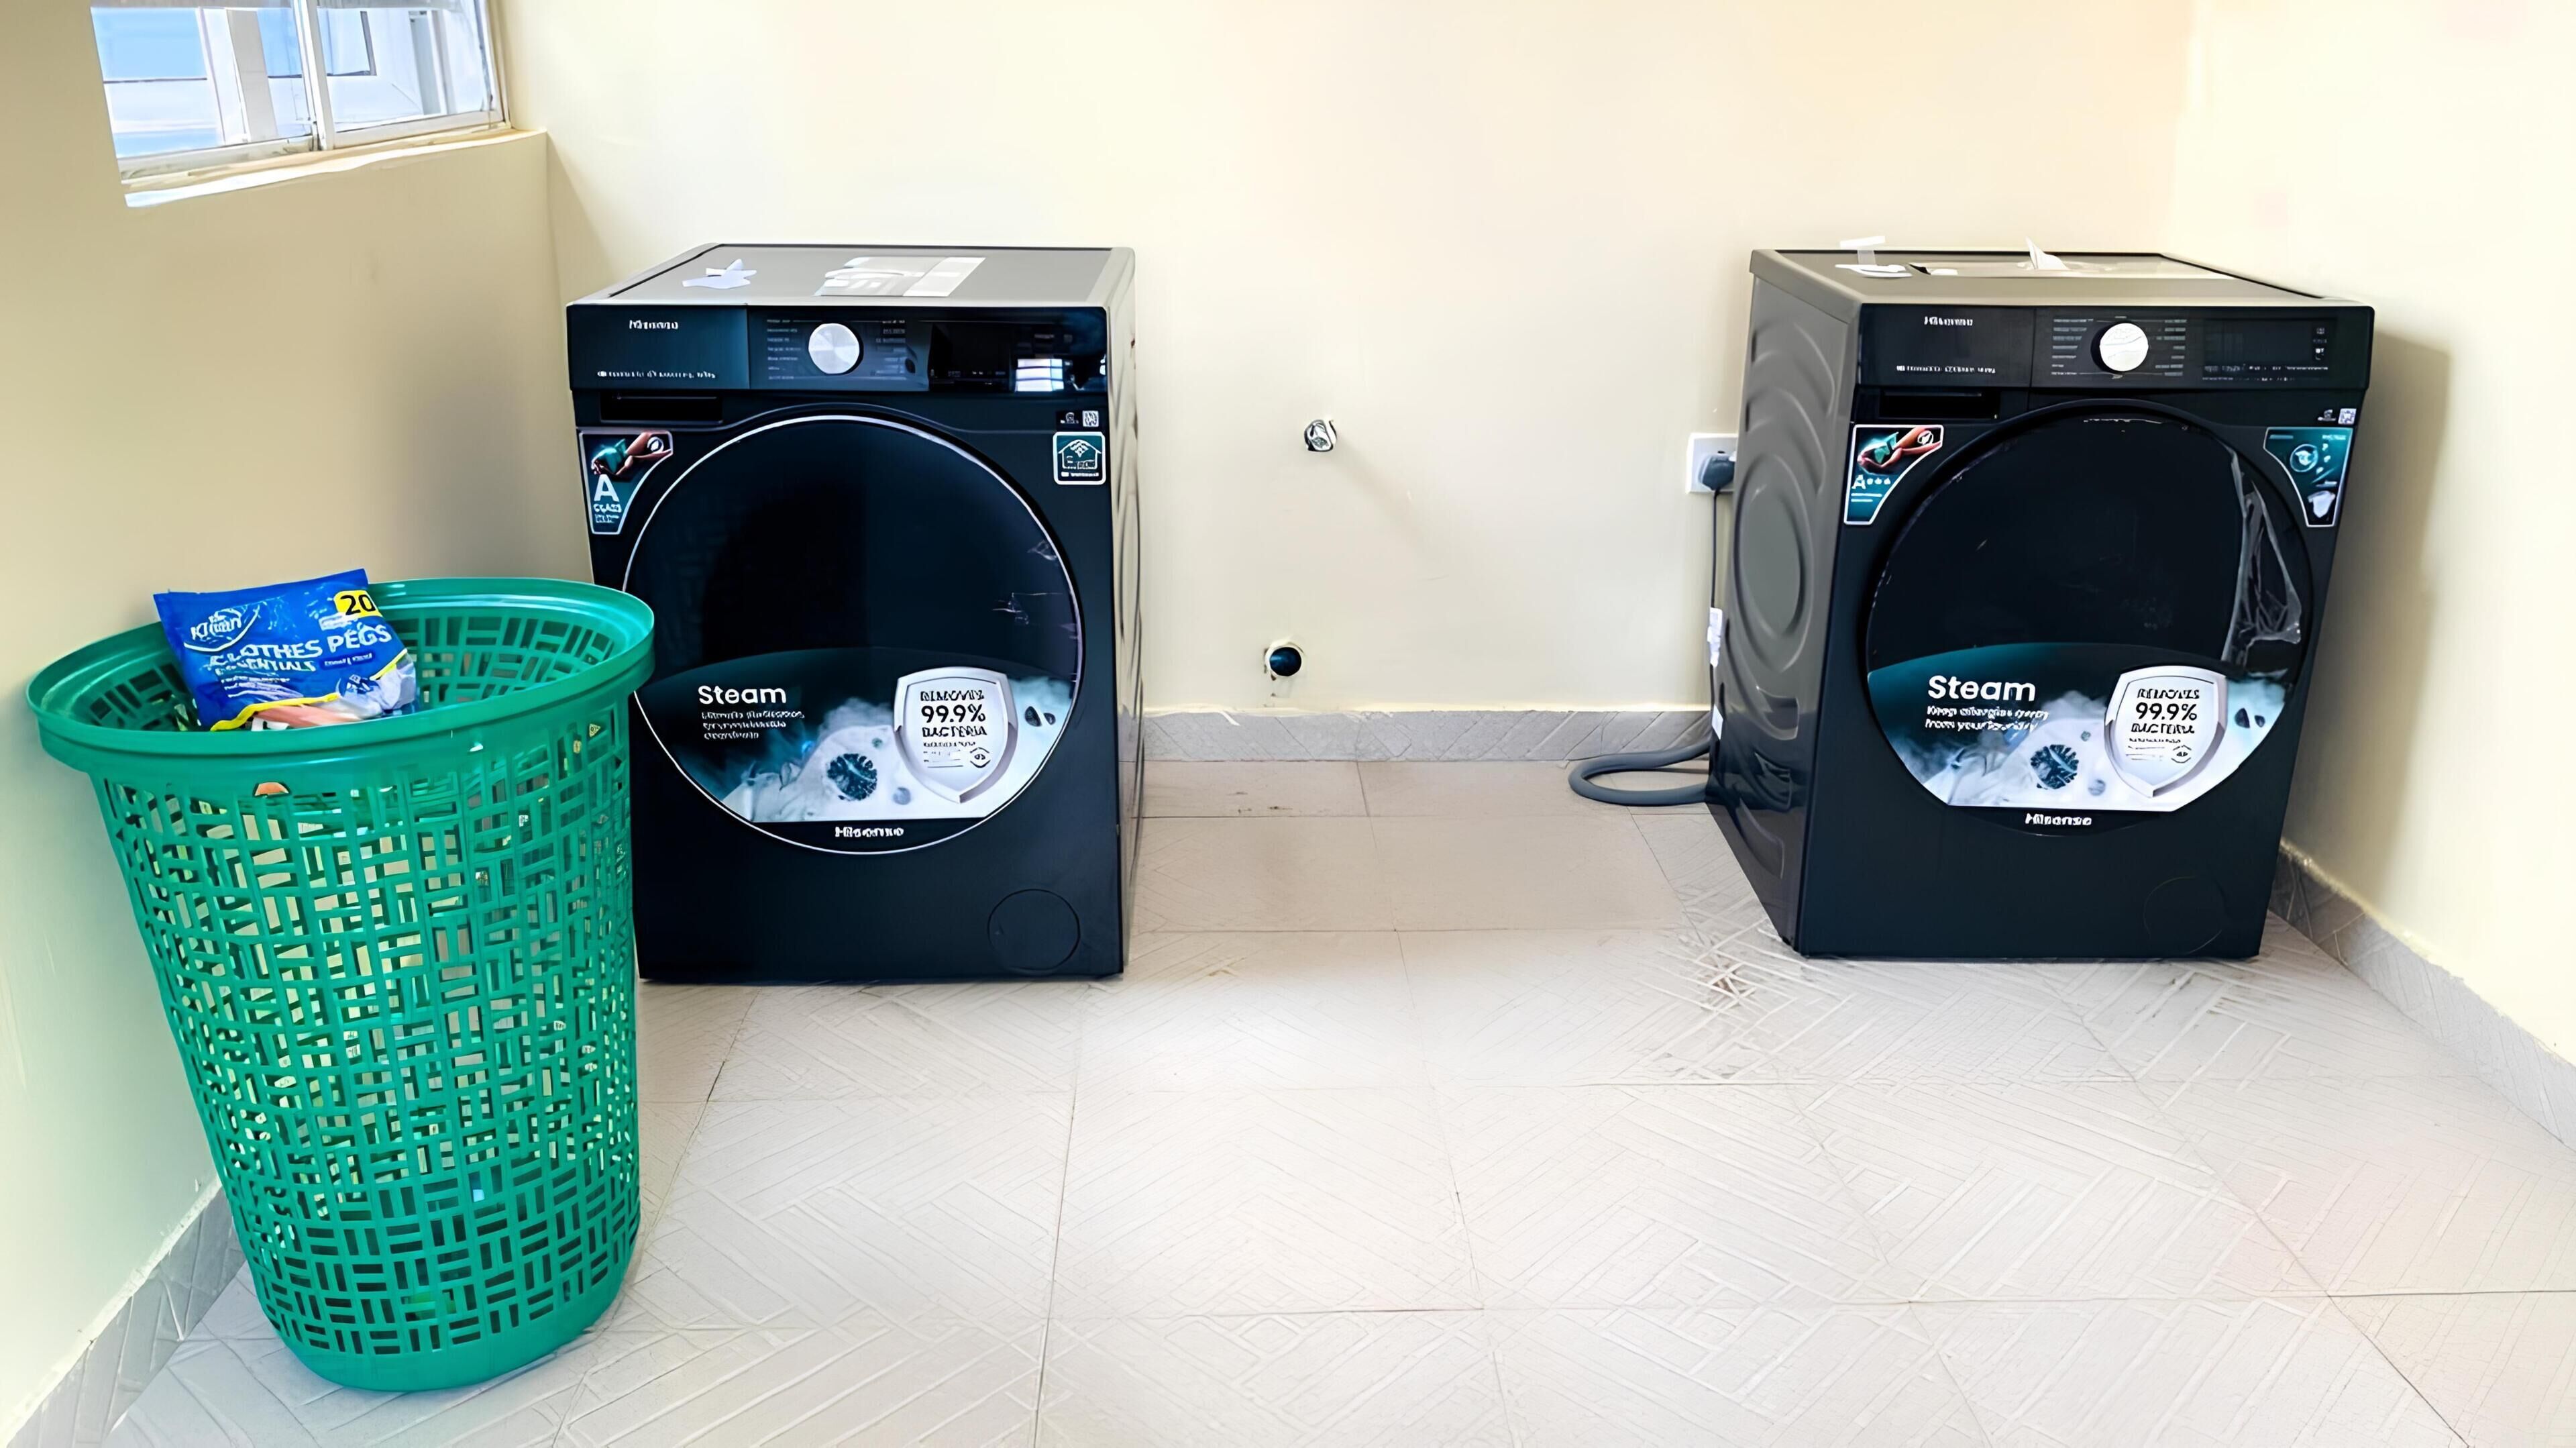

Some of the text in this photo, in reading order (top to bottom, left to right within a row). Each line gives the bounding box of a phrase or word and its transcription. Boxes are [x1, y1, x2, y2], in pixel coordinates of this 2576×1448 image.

[594, 474, 619, 502] A
[340, 595, 376, 615] 20
[210, 639, 323, 666] CLOTHES
[327, 624, 392, 654] PEGS
[698, 685, 787, 705] Steam
[1928, 675, 2036, 701] Steam
[921, 703, 986, 723] 99.9%
[2135, 702, 2198, 721] 99.9%
